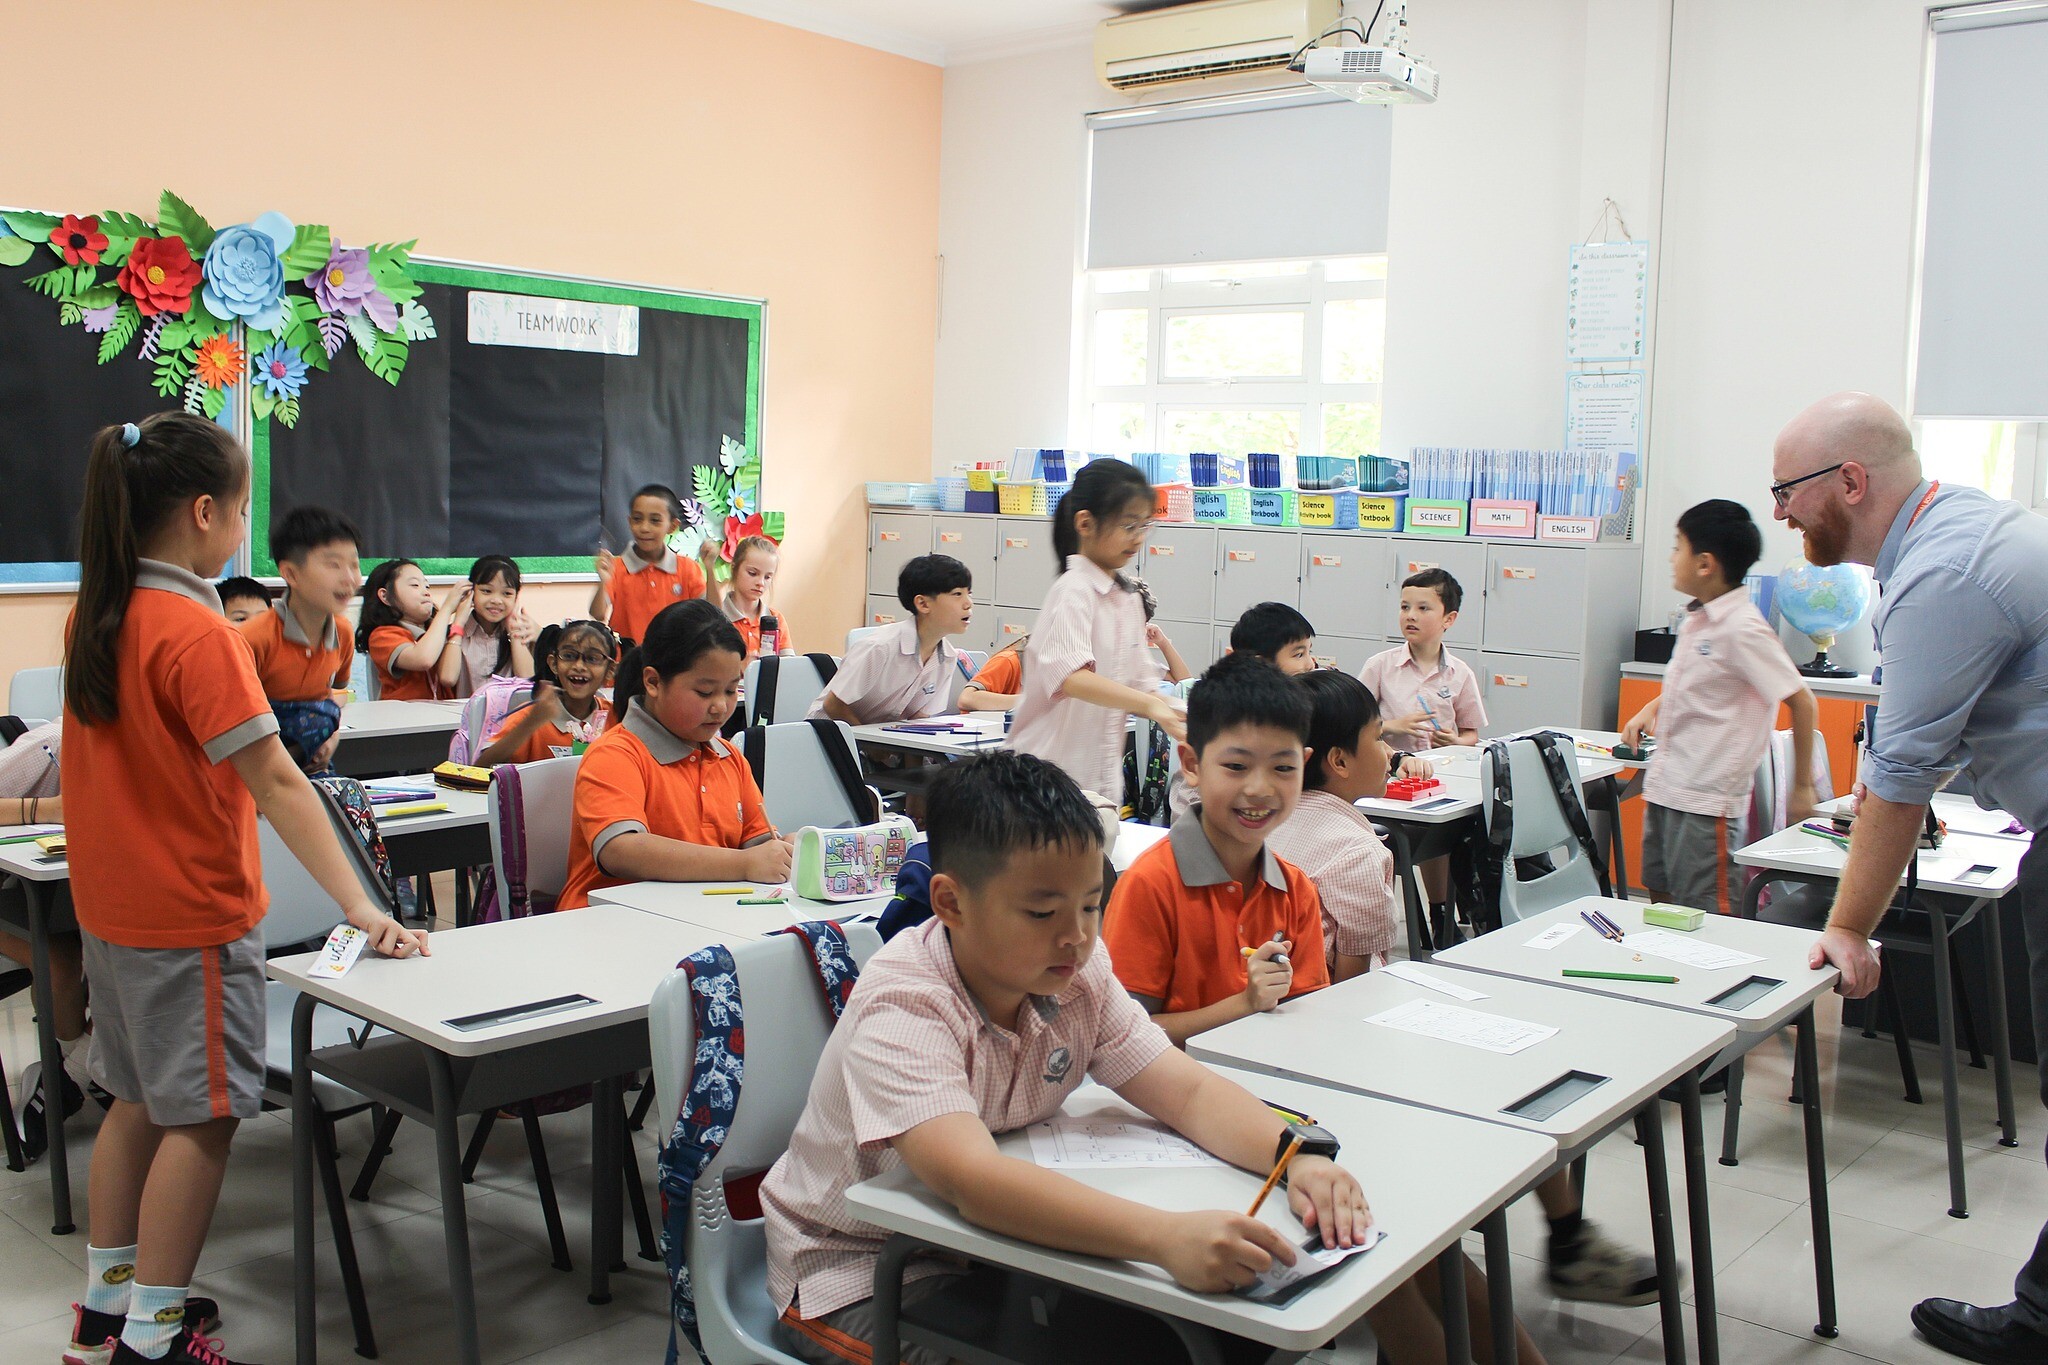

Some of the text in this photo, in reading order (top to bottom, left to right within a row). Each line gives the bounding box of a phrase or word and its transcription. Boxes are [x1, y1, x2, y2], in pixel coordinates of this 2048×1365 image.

[1588, 252, 1600, 260] this
[517, 312, 597, 336] TEAMWORK
[1194, 495, 1220, 505] English
[1253, 498, 1274, 508] English
[1302, 501, 1325, 509] Science
[1361, 502, 1386, 510] Science
[1360, 513, 1391, 522] Textbook
[1420, 512, 1452, 522] SCIENCE
[1491, 513, 1512, 522] MATH
[1551, 525, 1587, 534] ENGLISH
